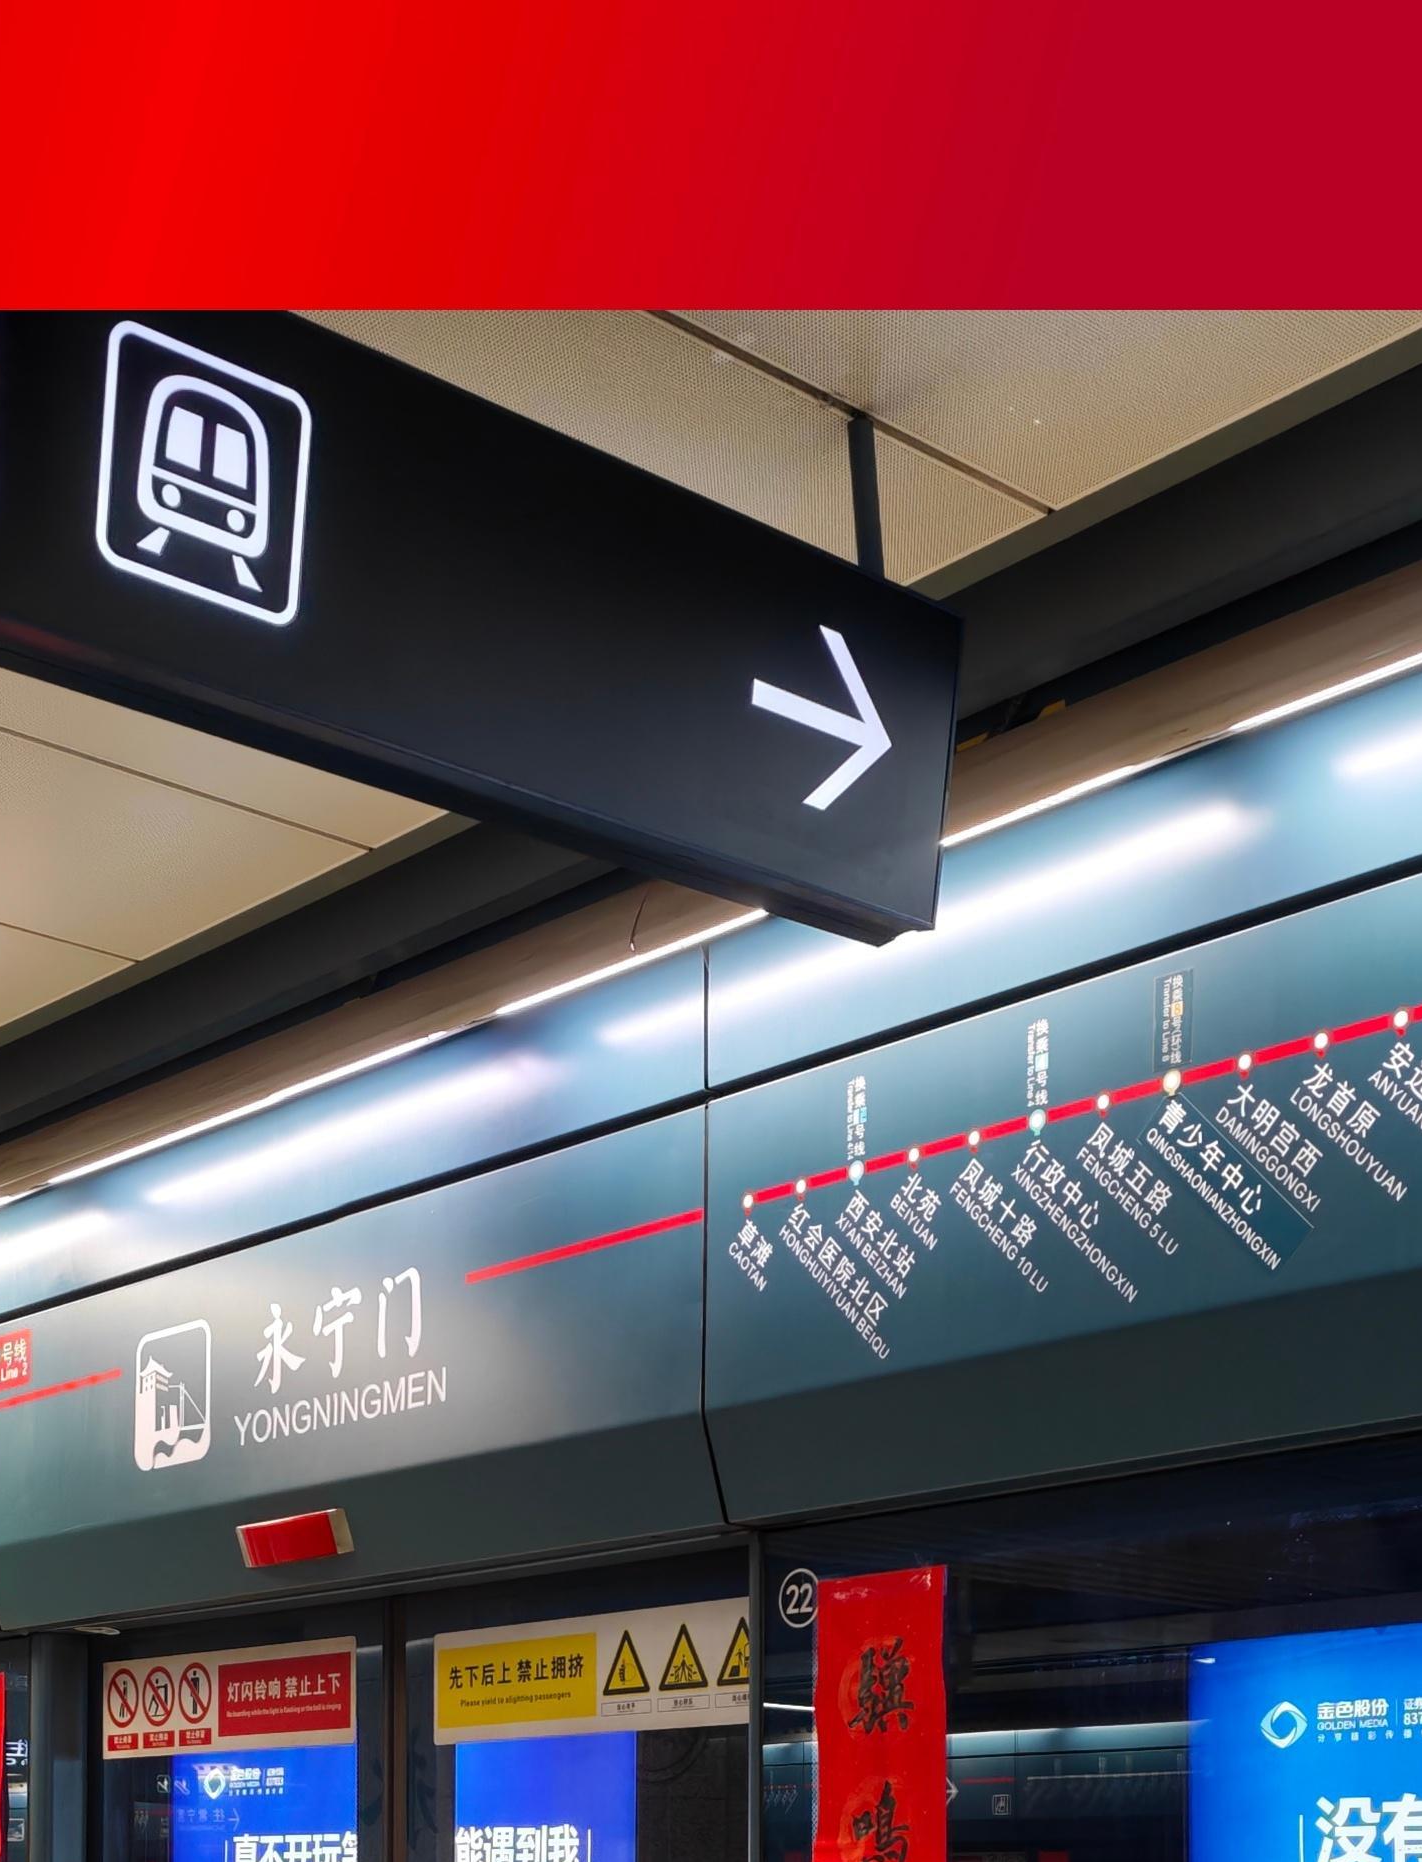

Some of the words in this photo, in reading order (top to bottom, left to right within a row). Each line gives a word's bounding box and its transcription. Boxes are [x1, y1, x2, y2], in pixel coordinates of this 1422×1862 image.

[1162, 1031, 1171, 1053] Line
[1227, 1083, 1324, 1179] 大明宫西
[1302, 1062, 1382, 1141] 龙首原
[1023, 1140, 1101, 1231] 行政中心
[1086, 1121, 1175, 1217] 凤城五路
[1157, 1099, 1263, 1217] 青少年中心
[1213, 1105, 1322, 1214] DAMINGGONGXI
[1288, 1086, 1409, 1203] LONGSHOUYUAN
[843, 1190, 918, 1280] 西安北站
[888, 1194, 939, 1252] BEIYUAN
[900, 1172, 944, 1223] 北苑
[958, 1158, 1039, 1250] 凤城十路
[1011, 1164, 1140, 1304] XINGZHENGZHONGXIN
[1075, 1146, 1151, 1230] FENGCHENG
[1148, 1221, 1160, 1240] 5
[1157, 1234, 1180, 1257] LU
[1145, 1127, 1283, 1272] QINGSHAONIANZHONGXIN
[727, 1241, 769, 1293] CAOTAN
[735, 1218, 775, 1271] 草滩
[786, 1203, 891, 1327] 红会医院北区
[859, 1241, 909, 1301] BEIZHAN
[948, 1183, 1017, 1263] FENGCHENG
[1015, 1256, 1034, 1279] 10
[1029, 1274, 1050, 1295] LU
[253, 1266, 423, 1394] 永宁门
[853, 1314, 892, 1361] BEIQU
[0, 1367, 19, 1382] Line
[21, 1361, 29, 1377] 2
[233, 1366, 448, 1448] YONGNINGMEN
[785, 1581, 814, 1617] 22
[227, 1677, 281, 1703] 灯闪铃响
[285, 1672, 342, 1699] 禁止上下
[449, 1660, 512, 1691] 先下后上
[517, 1653, 585, 1684] 禁止拥挤
[1316, 1698, 1389, 1721] 金色股份
[1316, 1719, 1357, 1732] GOLDEN
[1359, 1717, 1390, 1730] MEDIA
